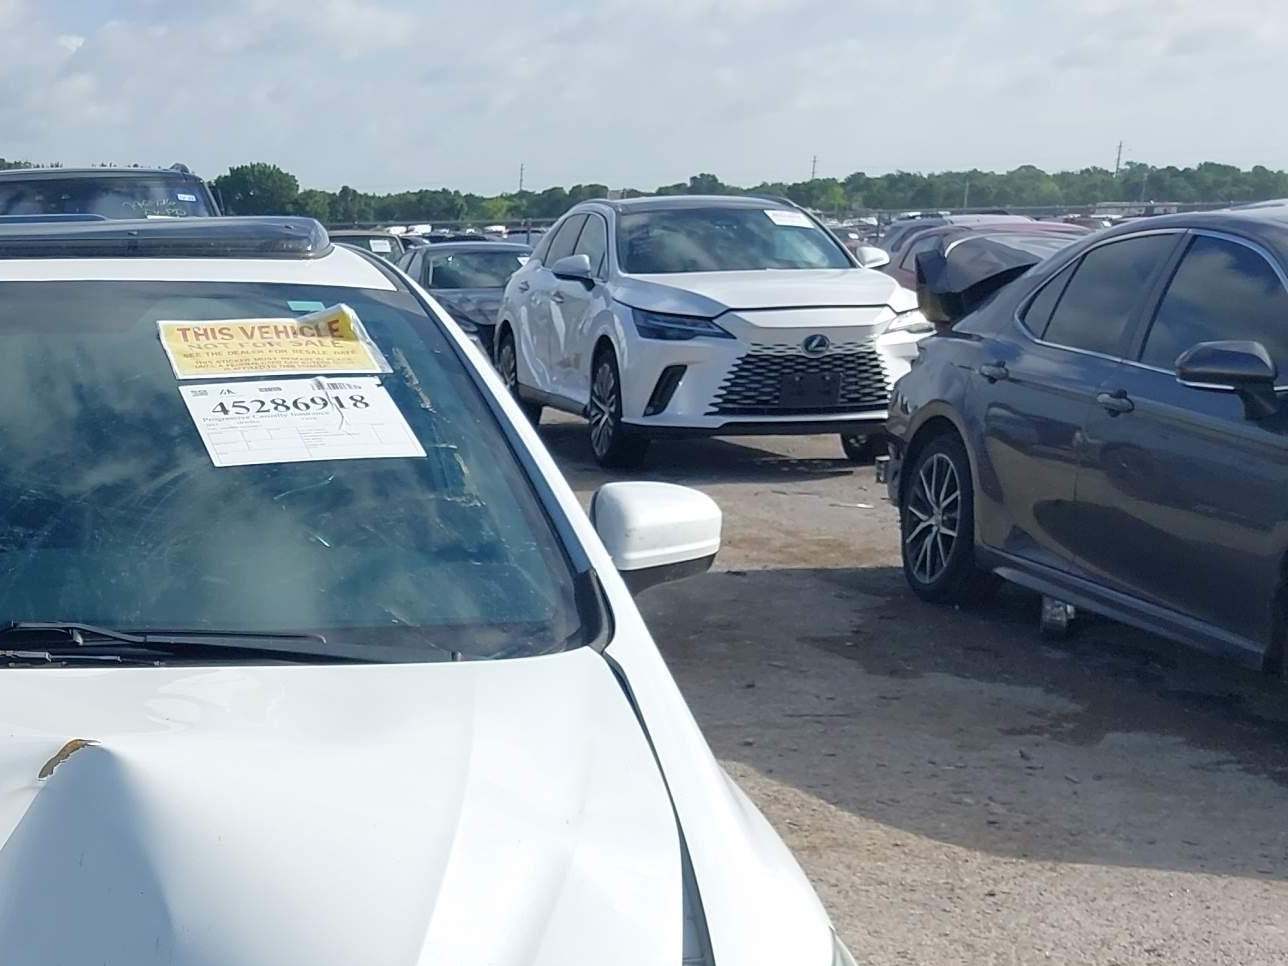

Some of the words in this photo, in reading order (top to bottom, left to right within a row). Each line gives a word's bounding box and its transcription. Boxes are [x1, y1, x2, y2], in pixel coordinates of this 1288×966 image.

[177, 326, 234, 343] THIS
[238, 319, 345, 341] VEHICLE
[188, 341, 231, 350] NOT
[238, 340, 281, 349] FOR
[289, 339, 345, 349] SALE
[211, 395, 370, 416] 45286918
